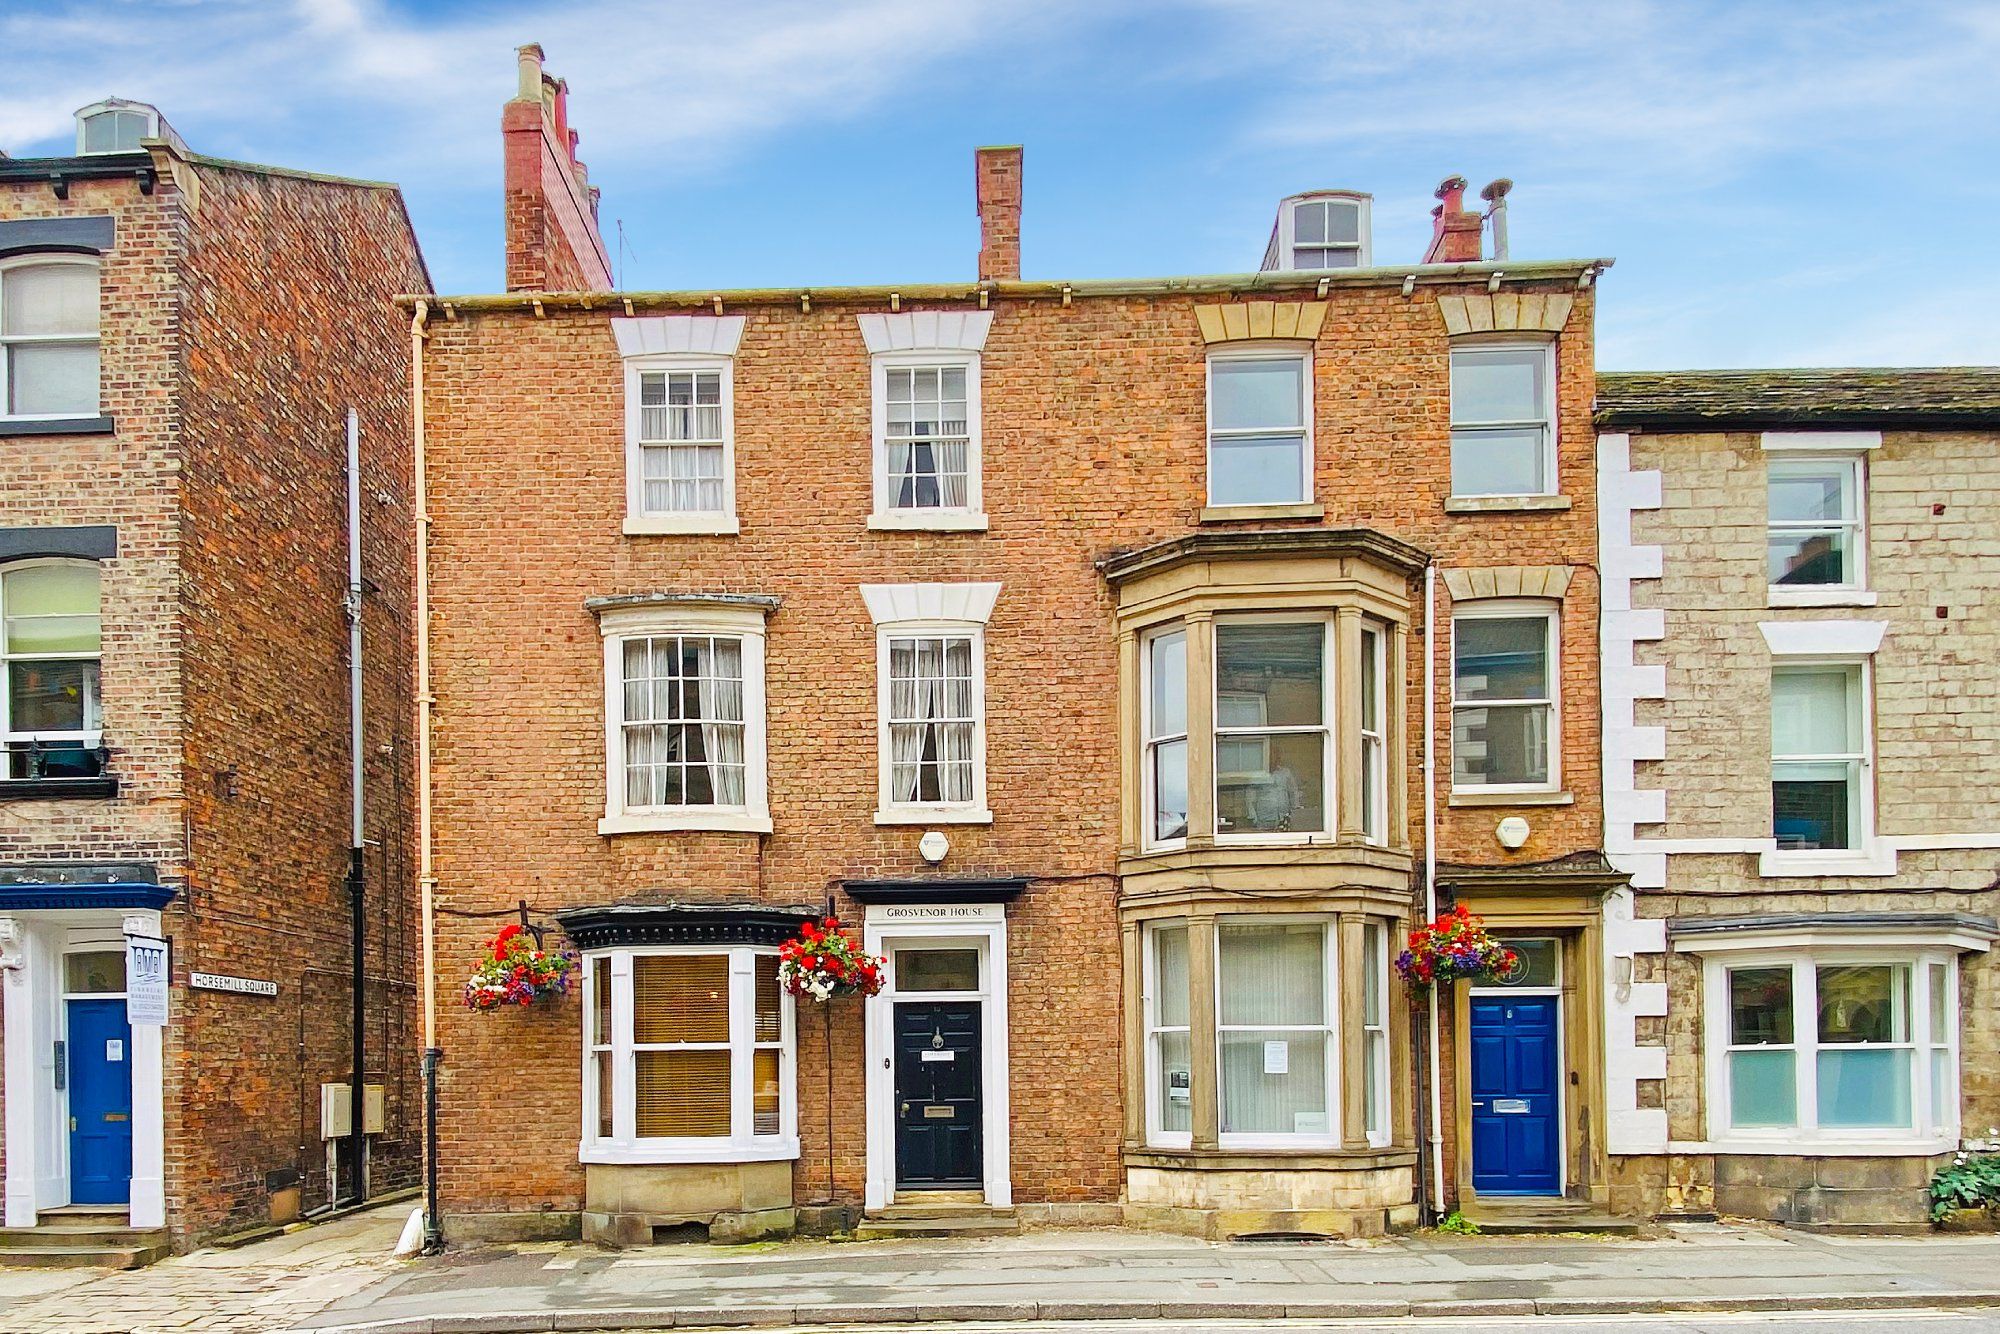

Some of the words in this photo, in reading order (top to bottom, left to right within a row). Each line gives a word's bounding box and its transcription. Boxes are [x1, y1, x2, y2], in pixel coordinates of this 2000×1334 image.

[886, 908, 946, 917] GROSVENOR
[950, 907, 984, 917] HOUSE
[195, 974, 243, 991] HORSEMILL
[245, 980, 275, 994] SQUARE
